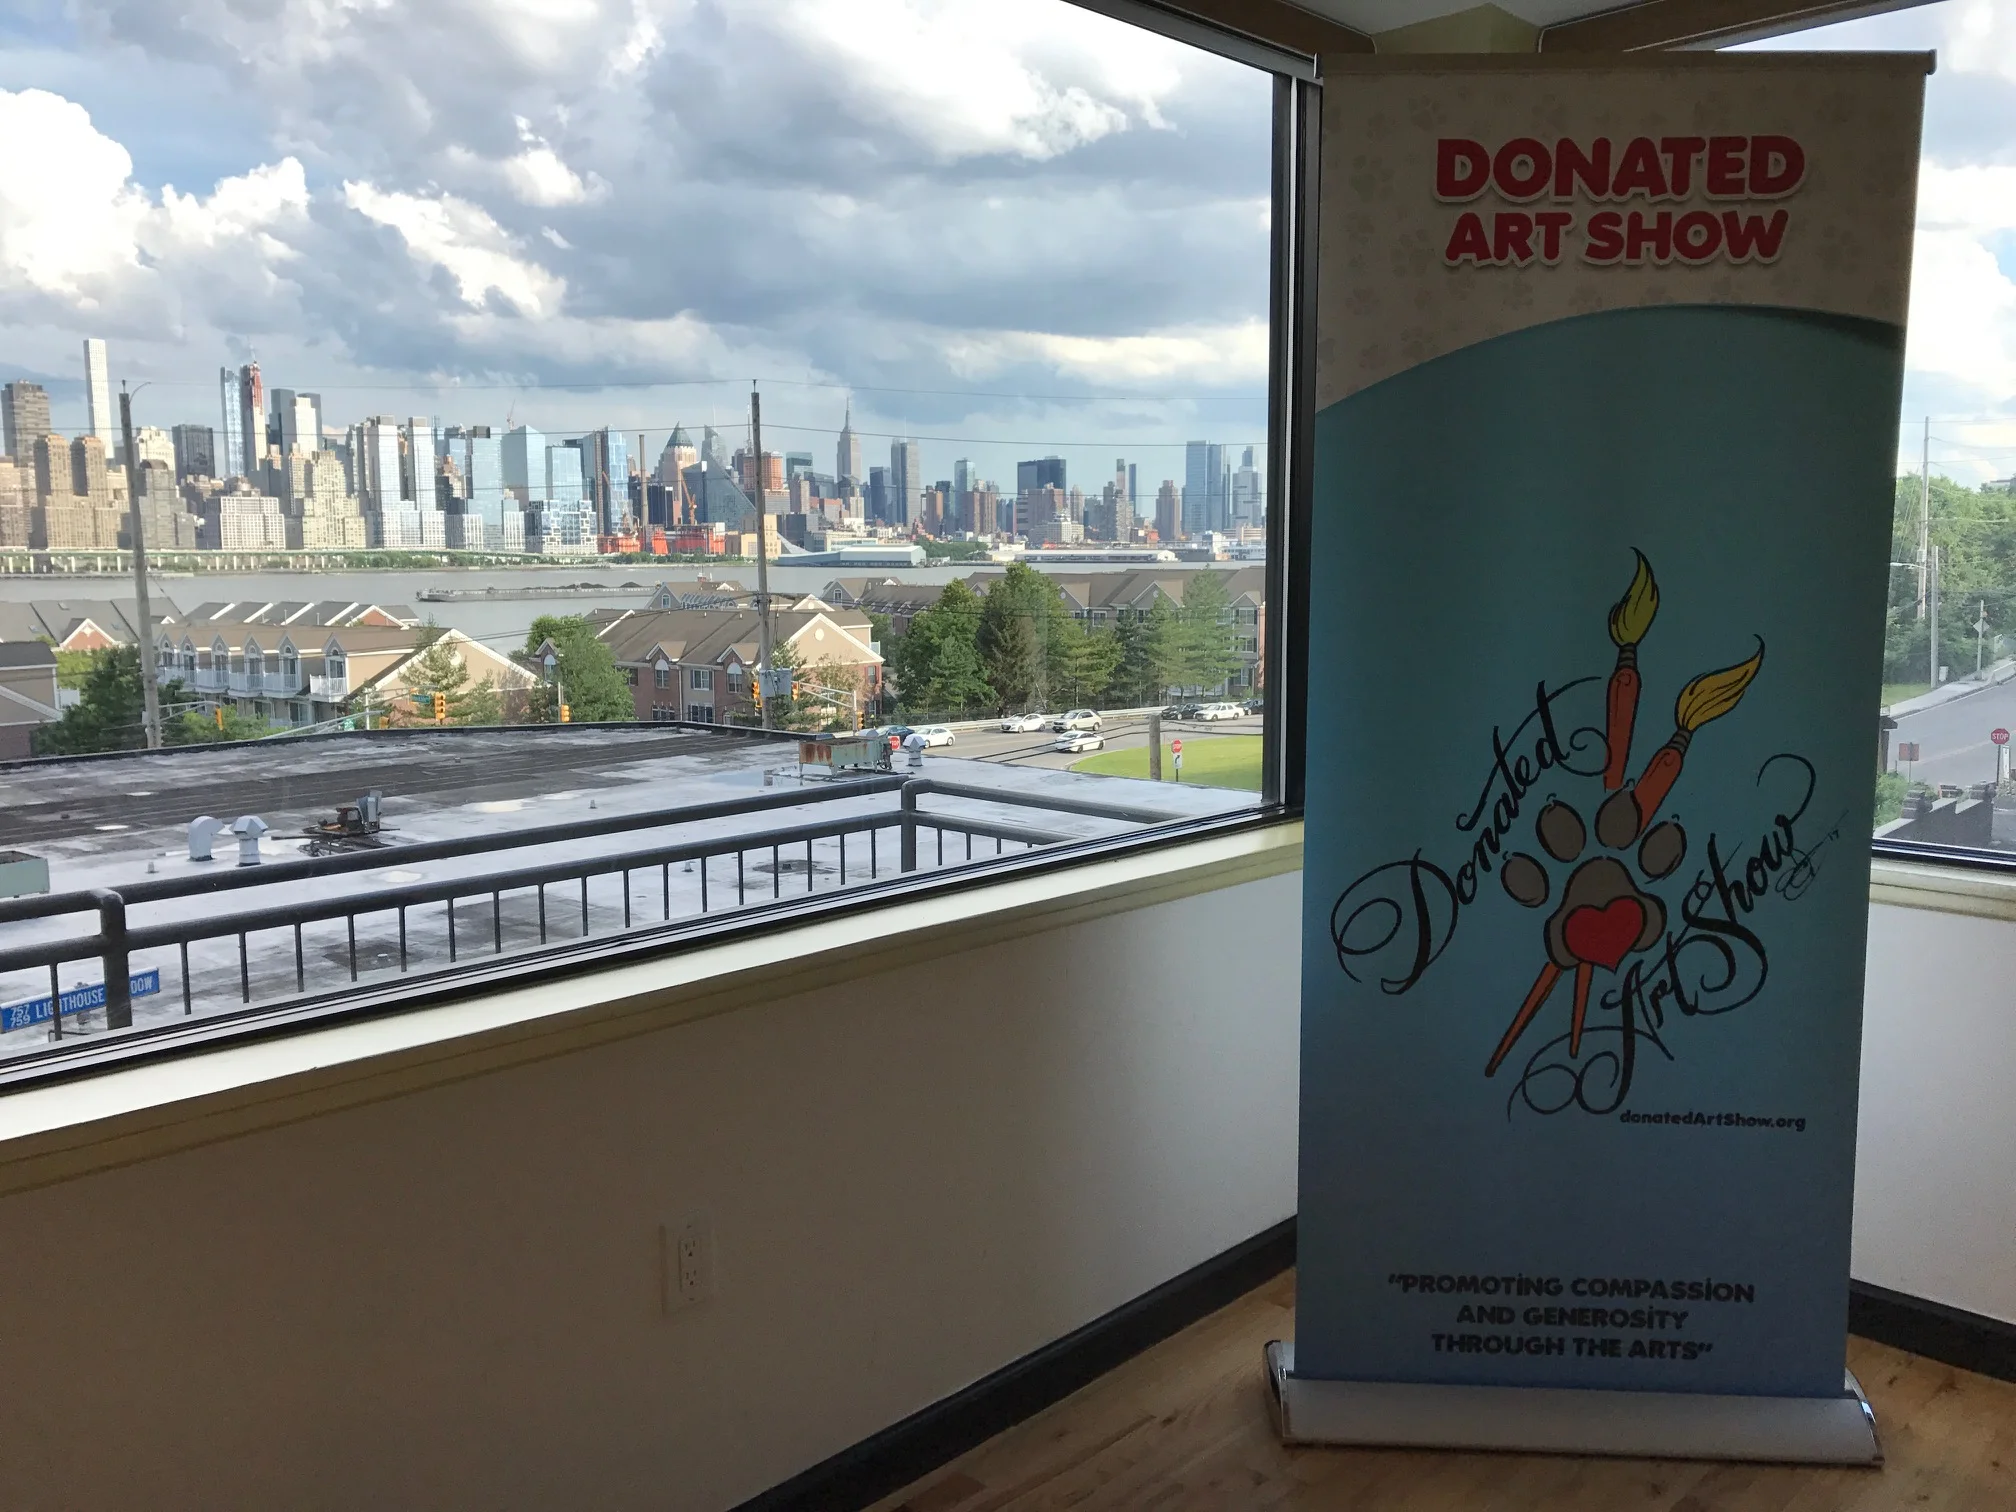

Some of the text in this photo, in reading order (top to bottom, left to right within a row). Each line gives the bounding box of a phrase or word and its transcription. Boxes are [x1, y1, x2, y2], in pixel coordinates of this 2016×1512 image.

[1436, 134, 1806, 198] DONATED
[1444, 208, 1790, 263] ART SHOW
[1992, 732, 2009, 740] STOP
[1330, 676, 1612, 995] Donated
[1619, 1109, 1807, 1132] donatedArtShow.org
[1456, 1305, 1516, 1325] AND
[1431, 1333, 1566, 1356] THROUGH
[1573, 1338, 1622, 1358] THE
